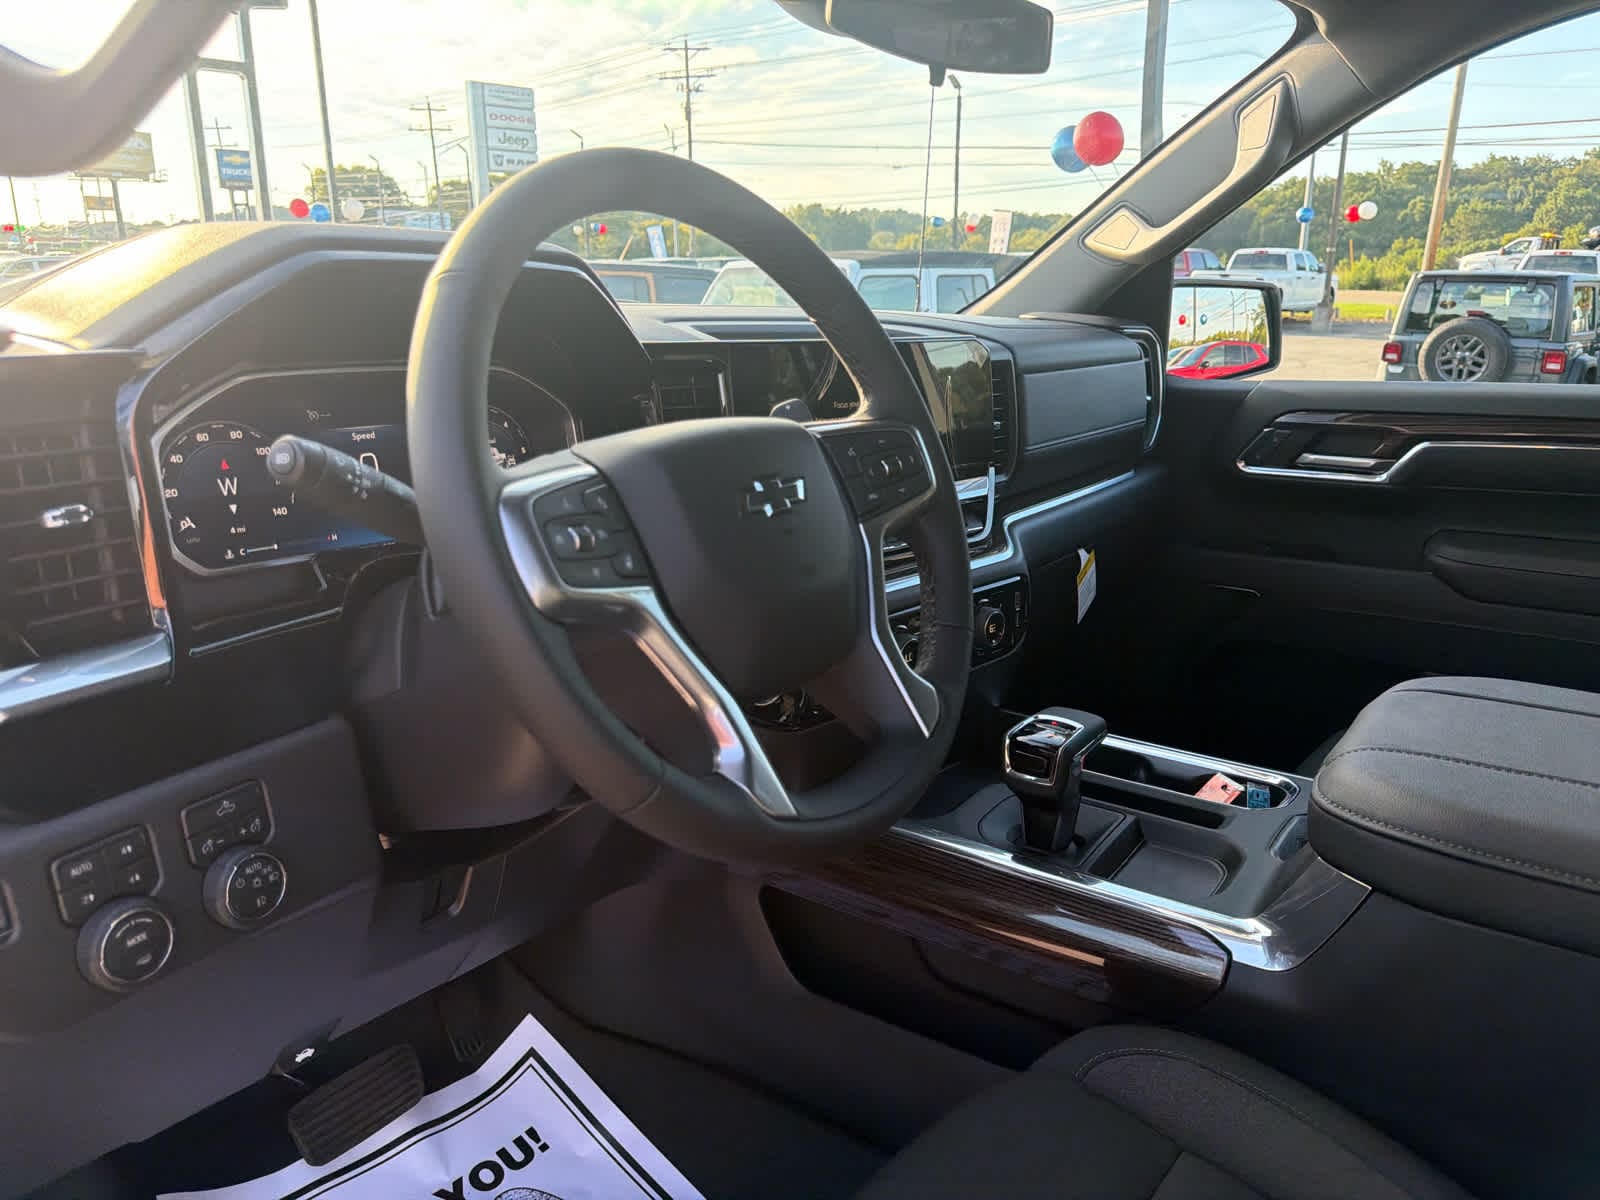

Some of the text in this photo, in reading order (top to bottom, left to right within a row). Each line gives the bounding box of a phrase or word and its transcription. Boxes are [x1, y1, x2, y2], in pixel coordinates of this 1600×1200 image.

[498, 132, 529, 150] Jeep
[196, 432, 209, 442] 60
[230, 430, 243, 440] 80
[351, 431, 376, 442] Speed
[256, 446, 272, 457] 100
[170, 454, 184, 464] 40
[217, 477, 238, 497] W
[165, 488, 178, 498] 20
[272, 506, 288, 517] 140
[71, 862, 93, 877] AUTO
[245, 861, 263, 875] AUTO
[432, 1126, 550, 1200] YOU!
